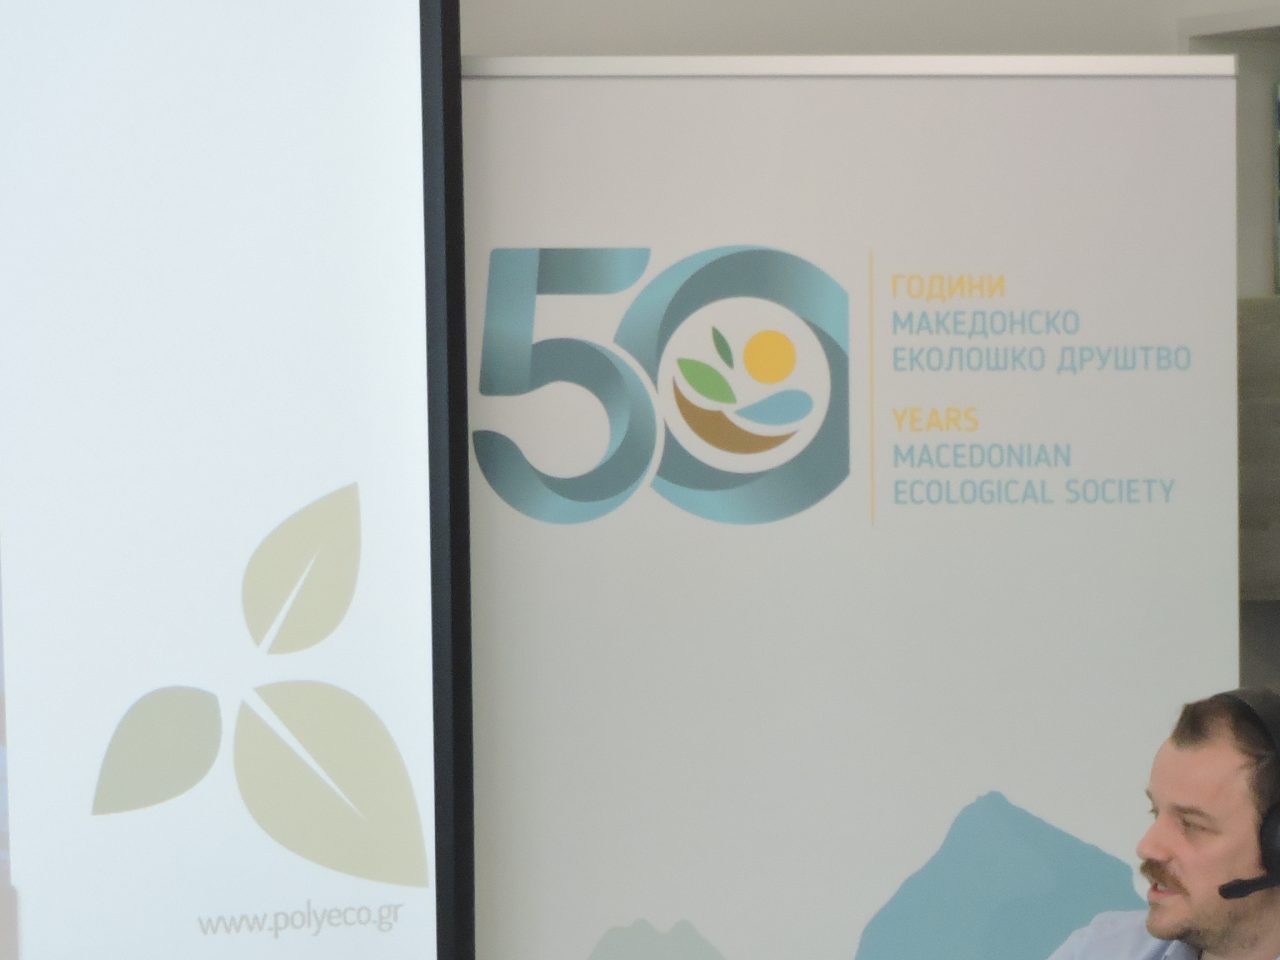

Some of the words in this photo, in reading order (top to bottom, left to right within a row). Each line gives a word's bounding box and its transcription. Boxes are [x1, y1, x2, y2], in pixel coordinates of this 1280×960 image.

[891, 273, 1006, 303] ГОДИНИ
[891, 309, 1081, 340] МАКЕДОНСКО
[892, 346, 1046, 373] ЕКОЛОШКО
[1056, 345, 1193, 375] ДРУШТВО
[472, 244, 851, 526] 50
[891, 406, 980, 433] YEARS
[892, 443, 1072, 469] MACEDONIAN
[893, 479, 1055, 506] ECOLOGICAL
[1064, 478, 1176, 505] SOCIETY
[197, 899, 404, 939] www.polyeco.gr
